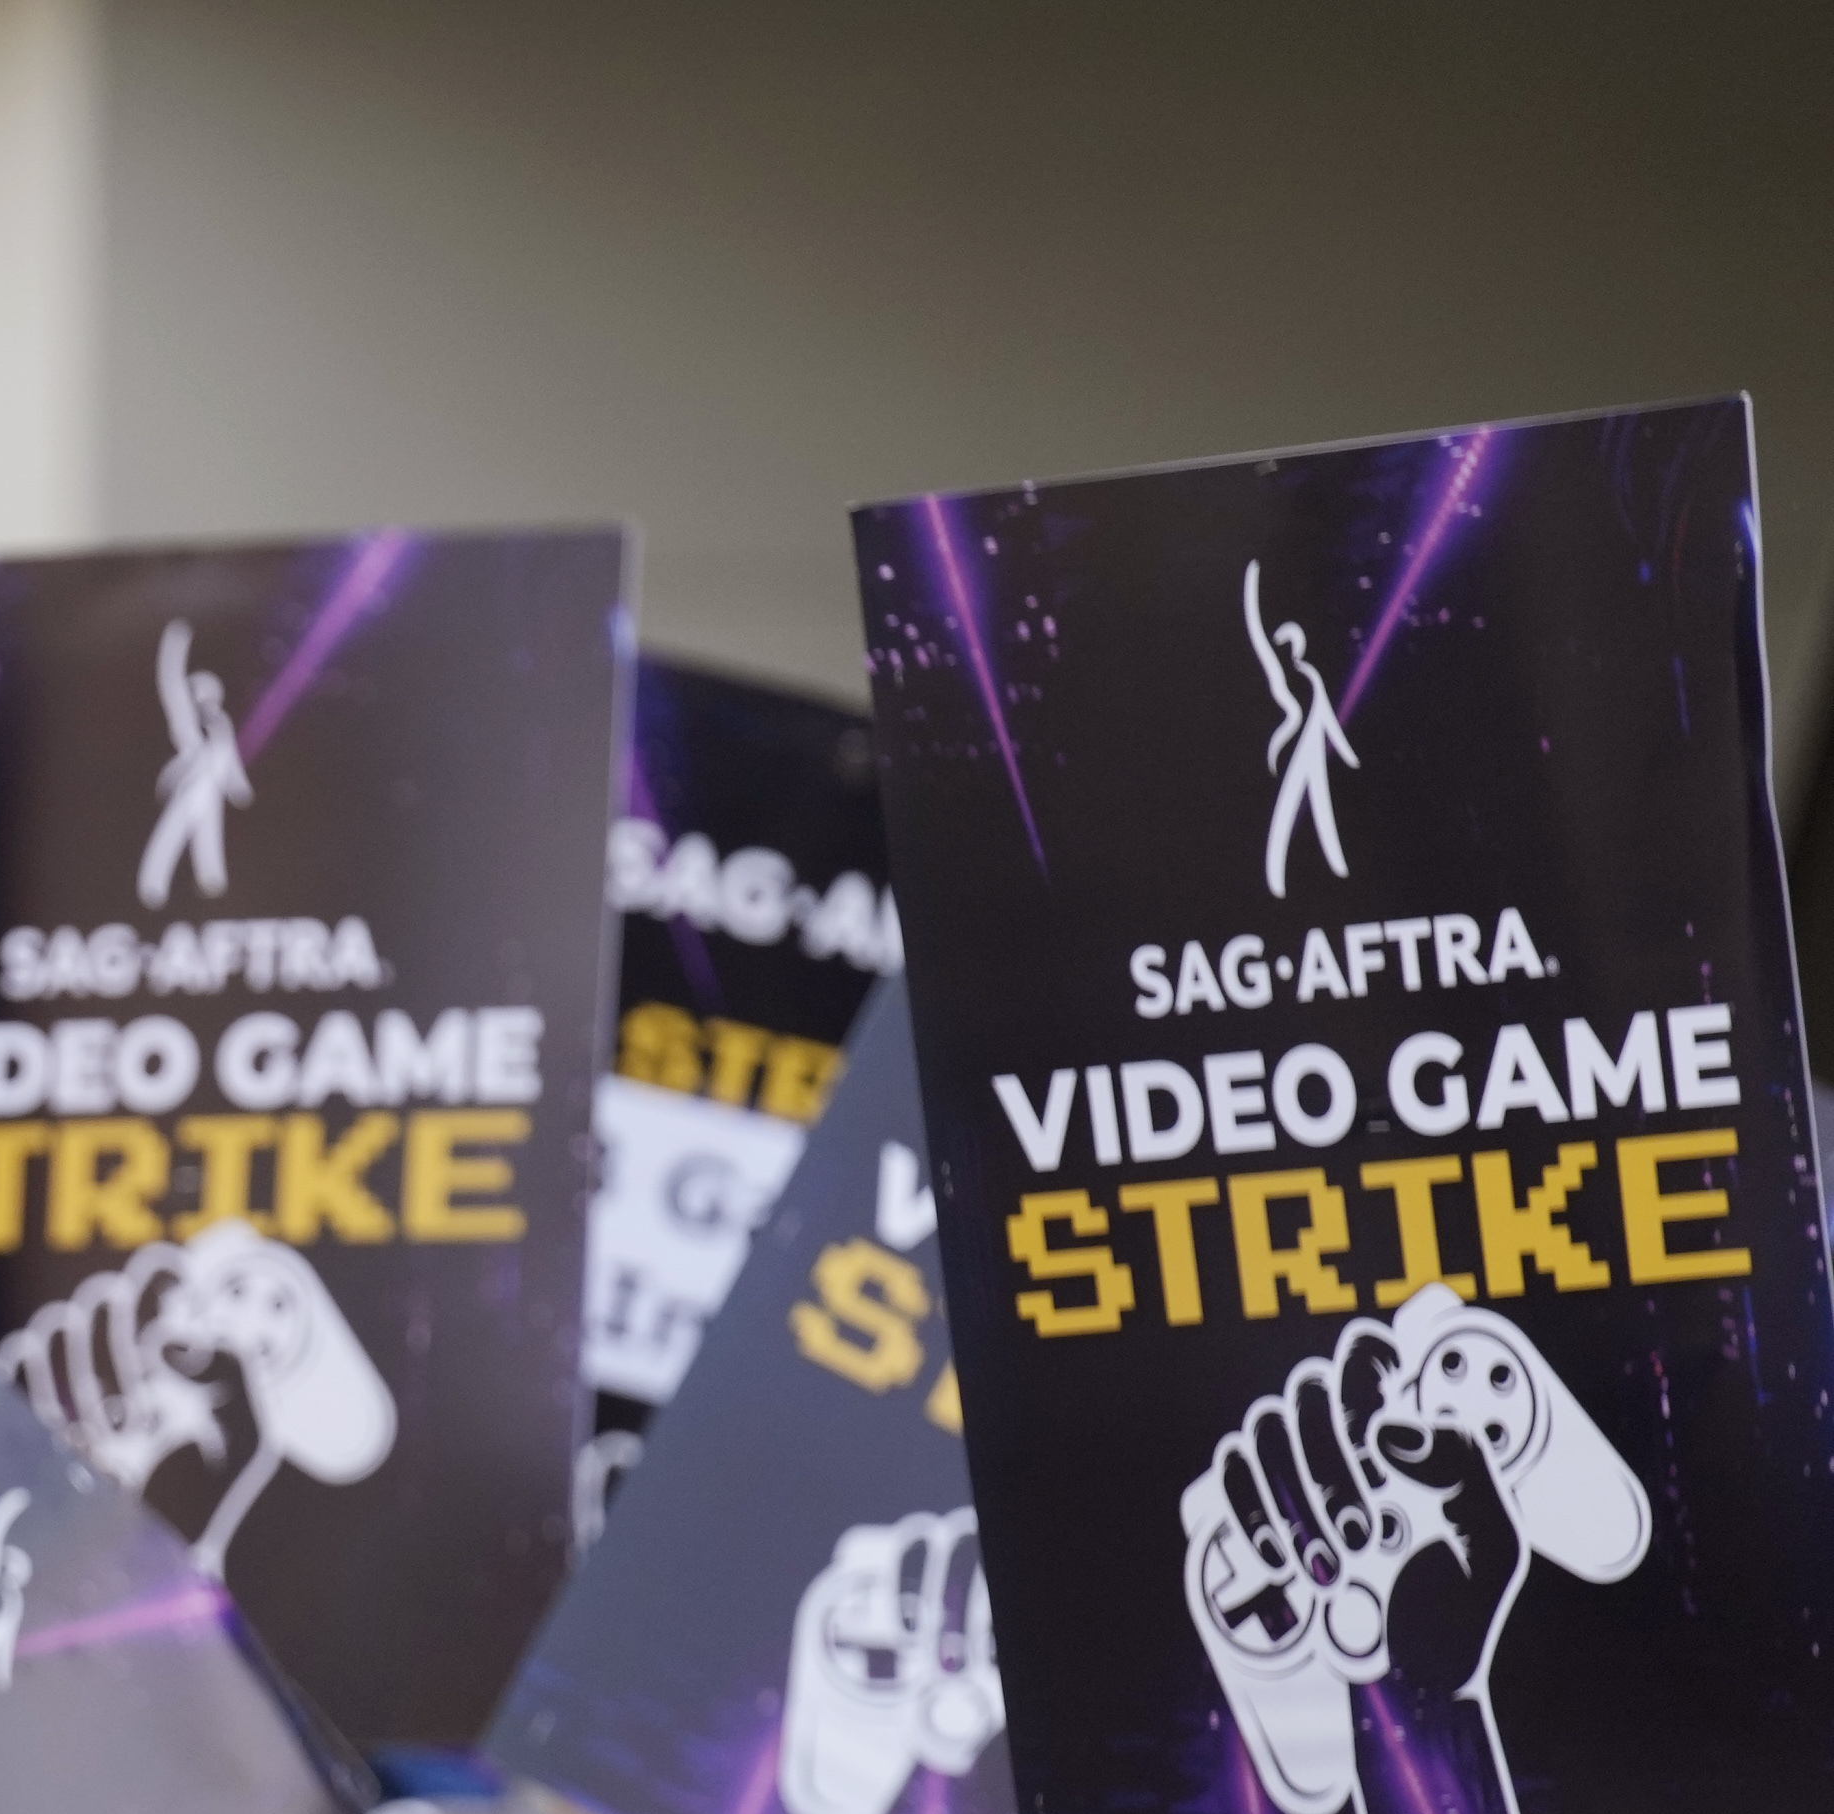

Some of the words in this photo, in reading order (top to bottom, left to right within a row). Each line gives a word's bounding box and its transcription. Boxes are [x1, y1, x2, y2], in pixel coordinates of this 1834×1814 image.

[215, 1006, 545, 1108] GAME
[992, 1042, 1357, 1173] VIDEO
[1387, 1004, 1742, 1136] GAME
[1005, 1128, 1753, 1338] STRIKE
